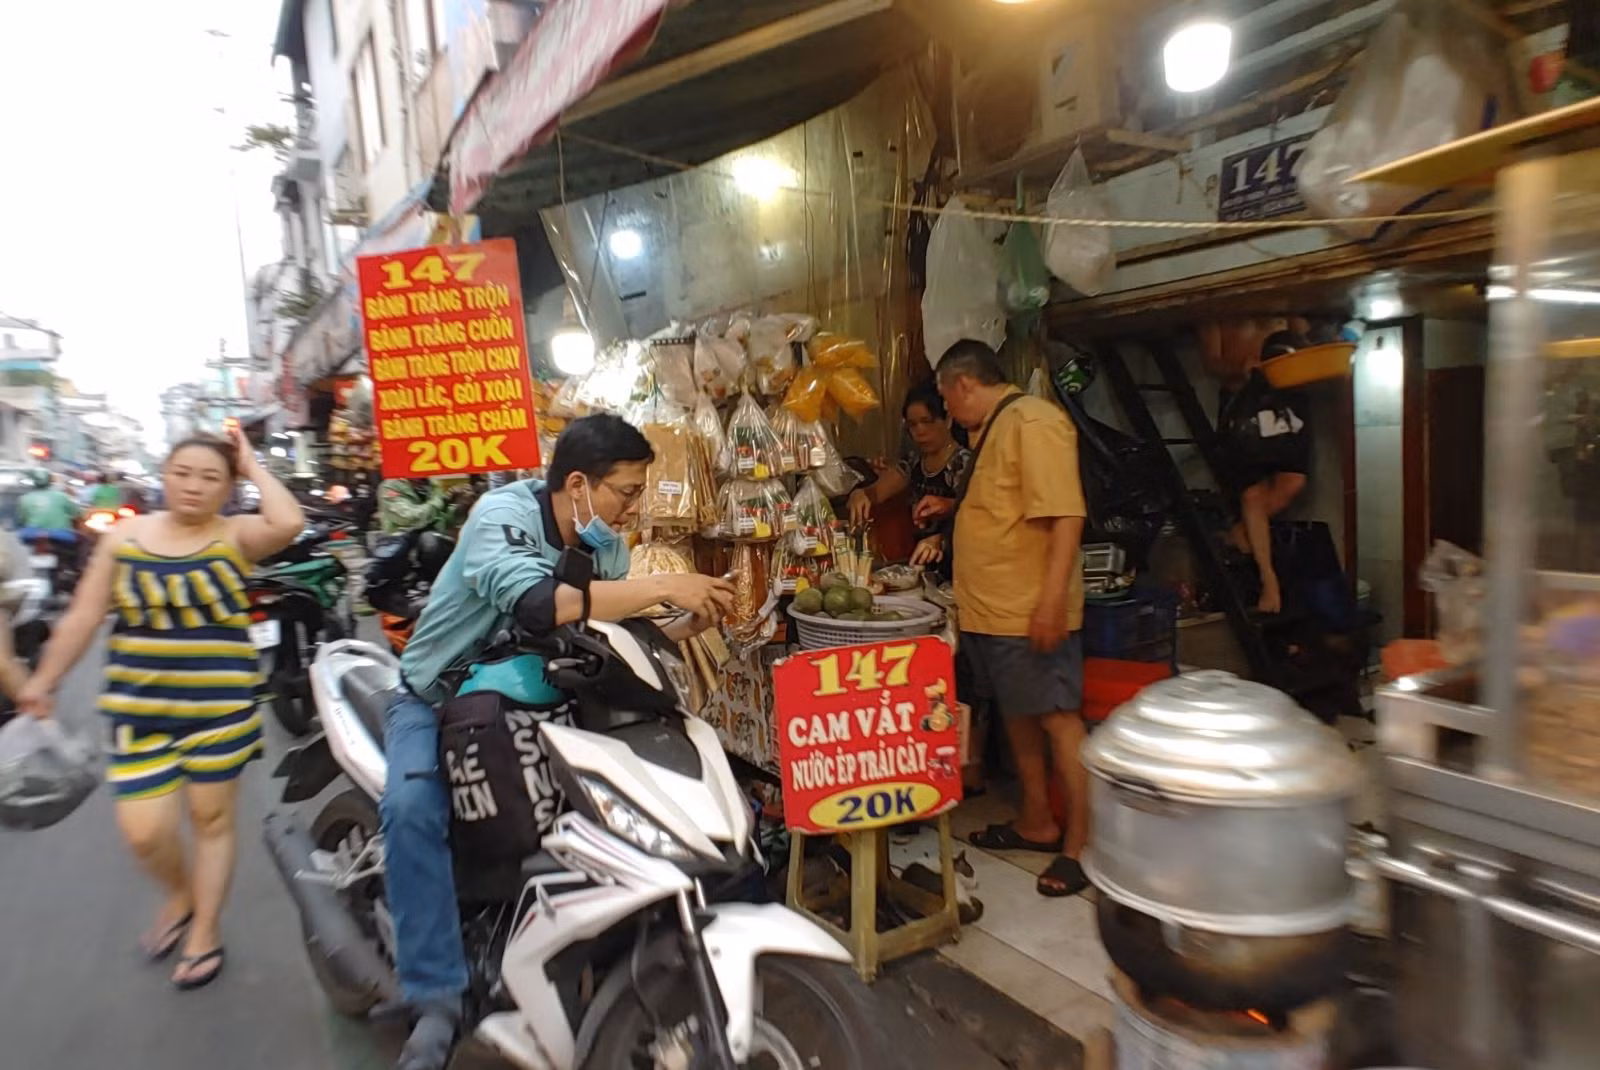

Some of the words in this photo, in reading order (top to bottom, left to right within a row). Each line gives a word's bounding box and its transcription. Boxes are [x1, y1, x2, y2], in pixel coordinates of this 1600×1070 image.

[380, 252, 486, 289] 147
[486, 346, 521, 373] CHAY
[407, 435, 512, 472] 20K
[808, 643, 918, 697] 147
[788, 711, 851, 747] CAM
[837, 786, 917, 825] 20K
